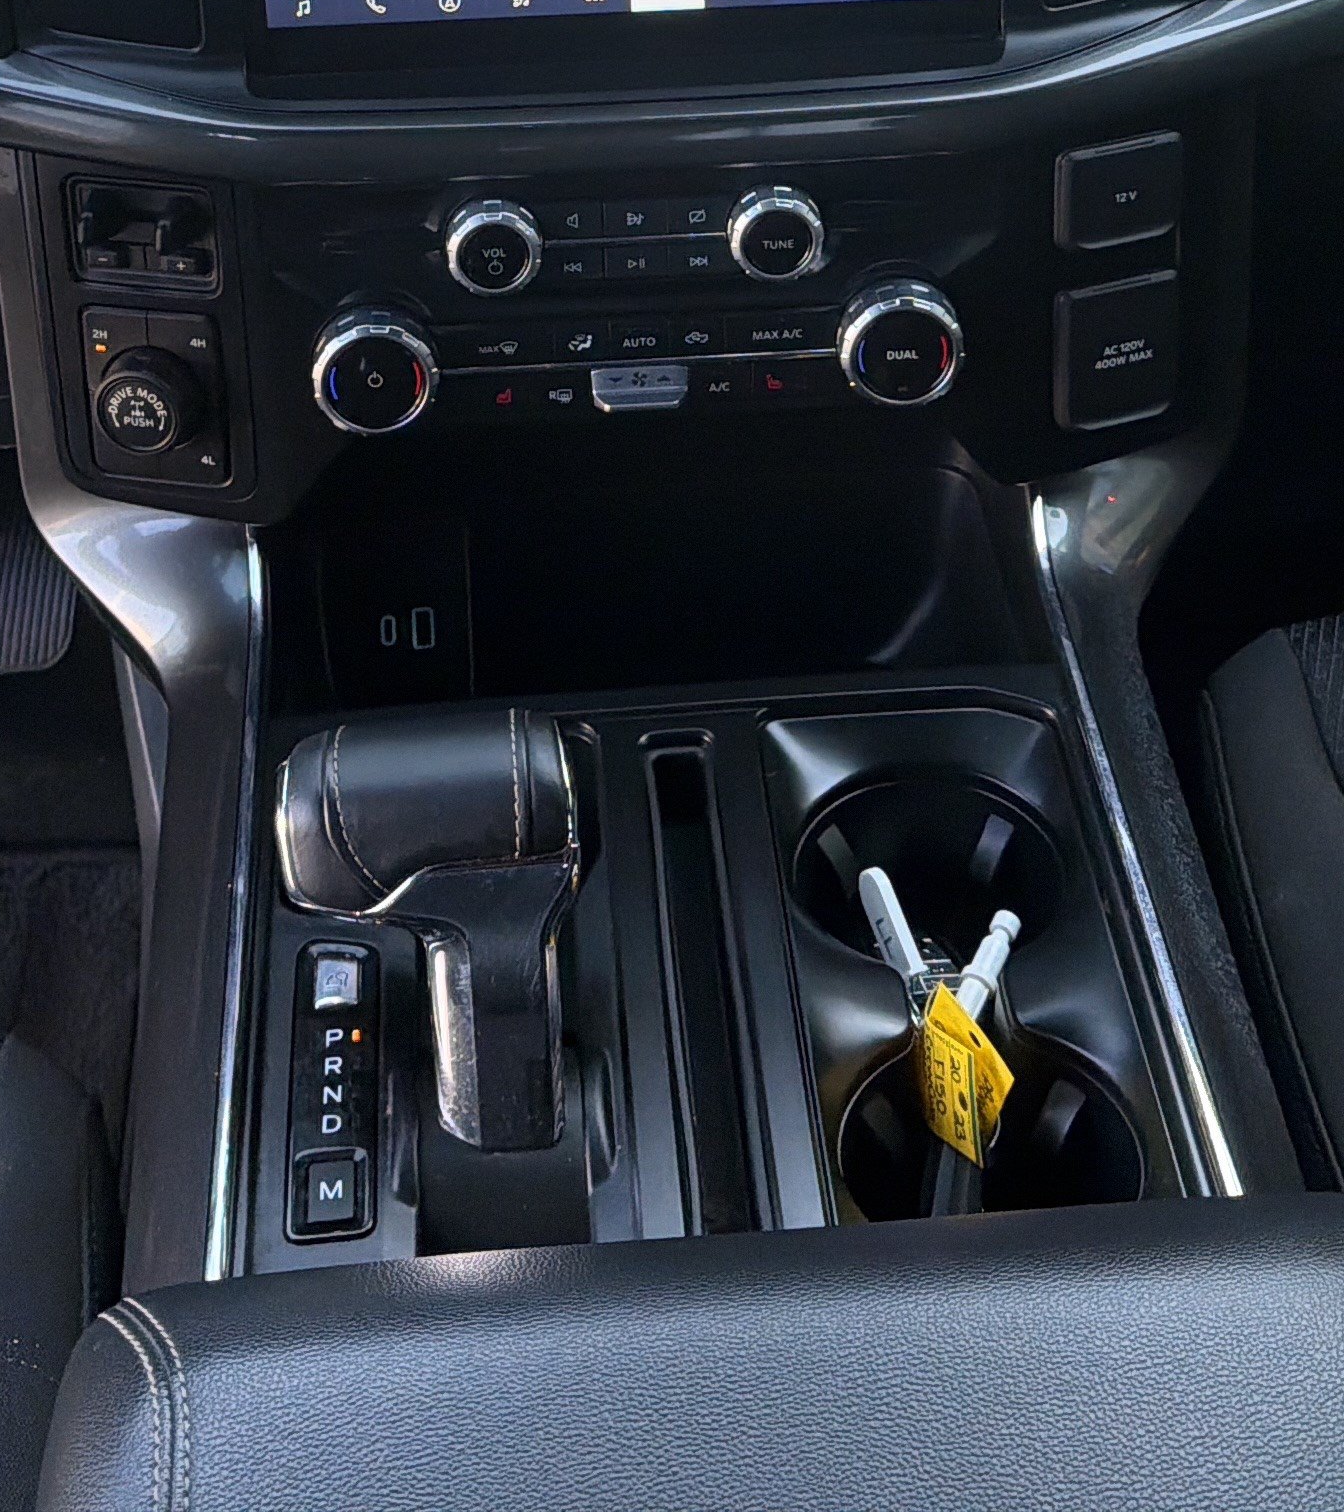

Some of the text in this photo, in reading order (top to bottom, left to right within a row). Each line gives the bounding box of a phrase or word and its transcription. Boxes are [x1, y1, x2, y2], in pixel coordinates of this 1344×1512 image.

[762, 239, 795, 250] TUNE
[482, 248, 506, 259] VOL
[92, 329, 108, 339] 2H
[752, 328, 803, 341] MAX A/C
[189, 338, 207, 349] 4H
[622, 336, 656, 348] AUTO
[1103, 339, 1145, 357] AC 120V
[886, 349, 919, 361] DUAL
[1094, 349, 1153, 370] 400W MAX
[709, 381, 730, 392] A/C
[108, 386, 168, 418] DRIVE MODE
[123, 415, 155, 428] PUSH
[200, 455, 216, 466] 4L
[325, 1029, 344, 1048] P
[324, 1056, 342, 1076] R
[323, 1085, 343, 1105] N
[321, 1114, 342, 1135] D
[319, 1180, 343, 1201] M
